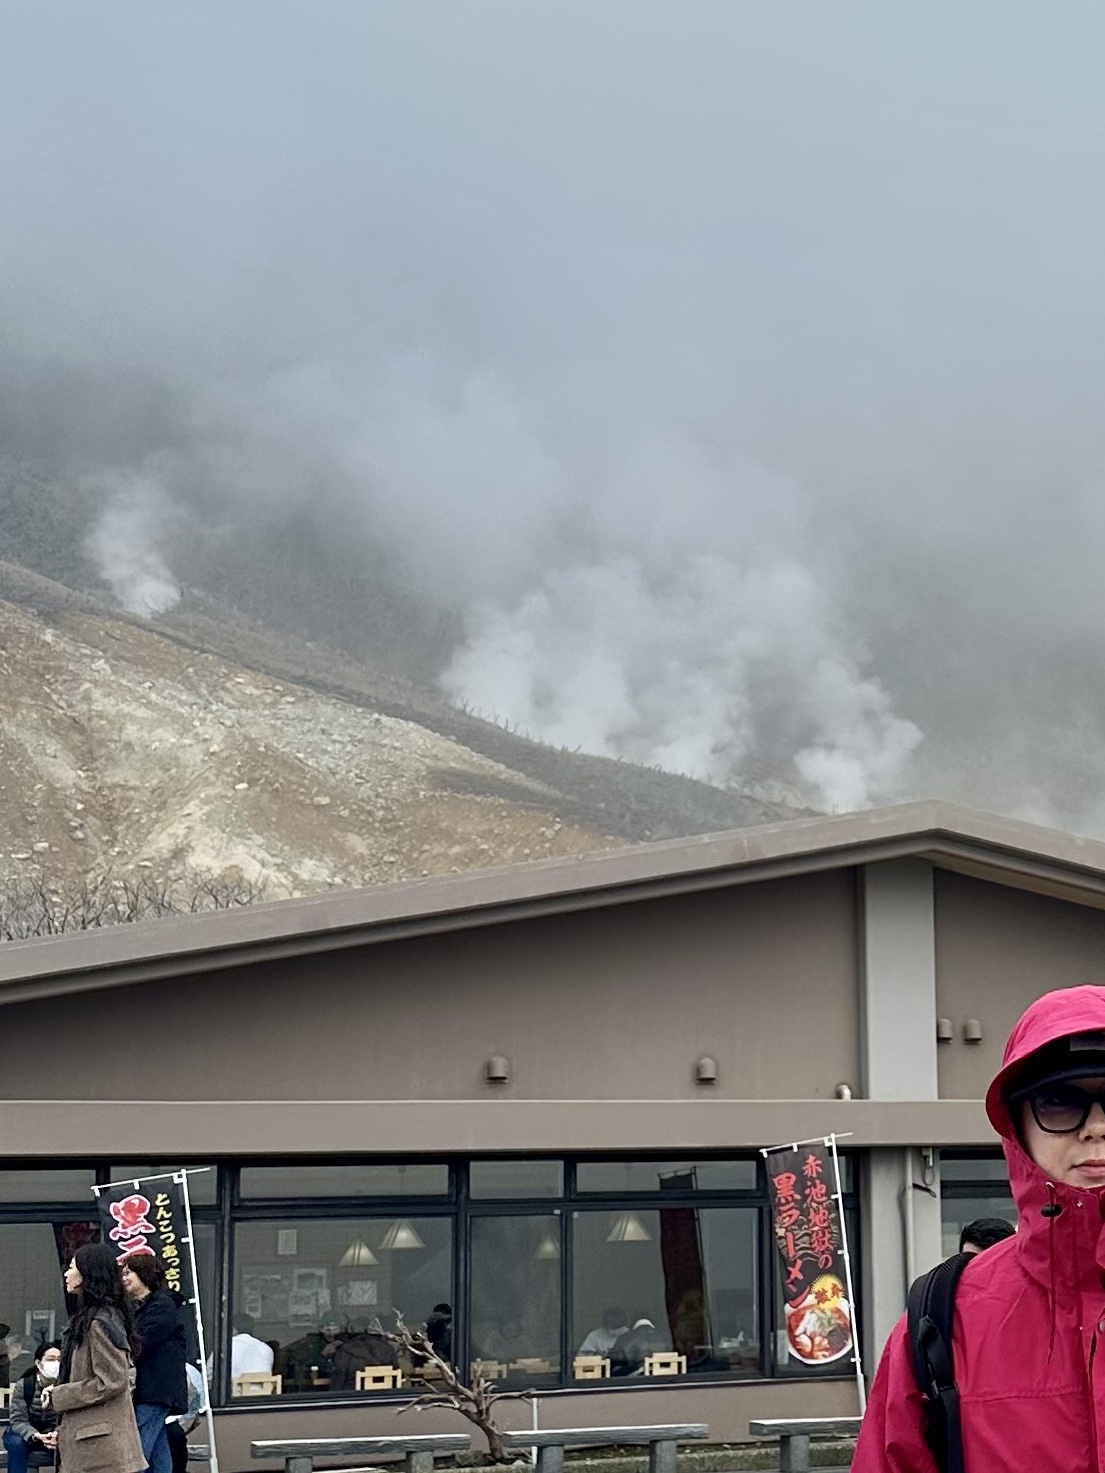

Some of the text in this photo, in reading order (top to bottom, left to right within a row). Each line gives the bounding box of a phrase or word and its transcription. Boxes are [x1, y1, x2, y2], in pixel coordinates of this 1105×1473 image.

[772, 1172, 812, 1309] 黒ラーメン
[801, 1153, 834, 1270] 赤池地獄の
